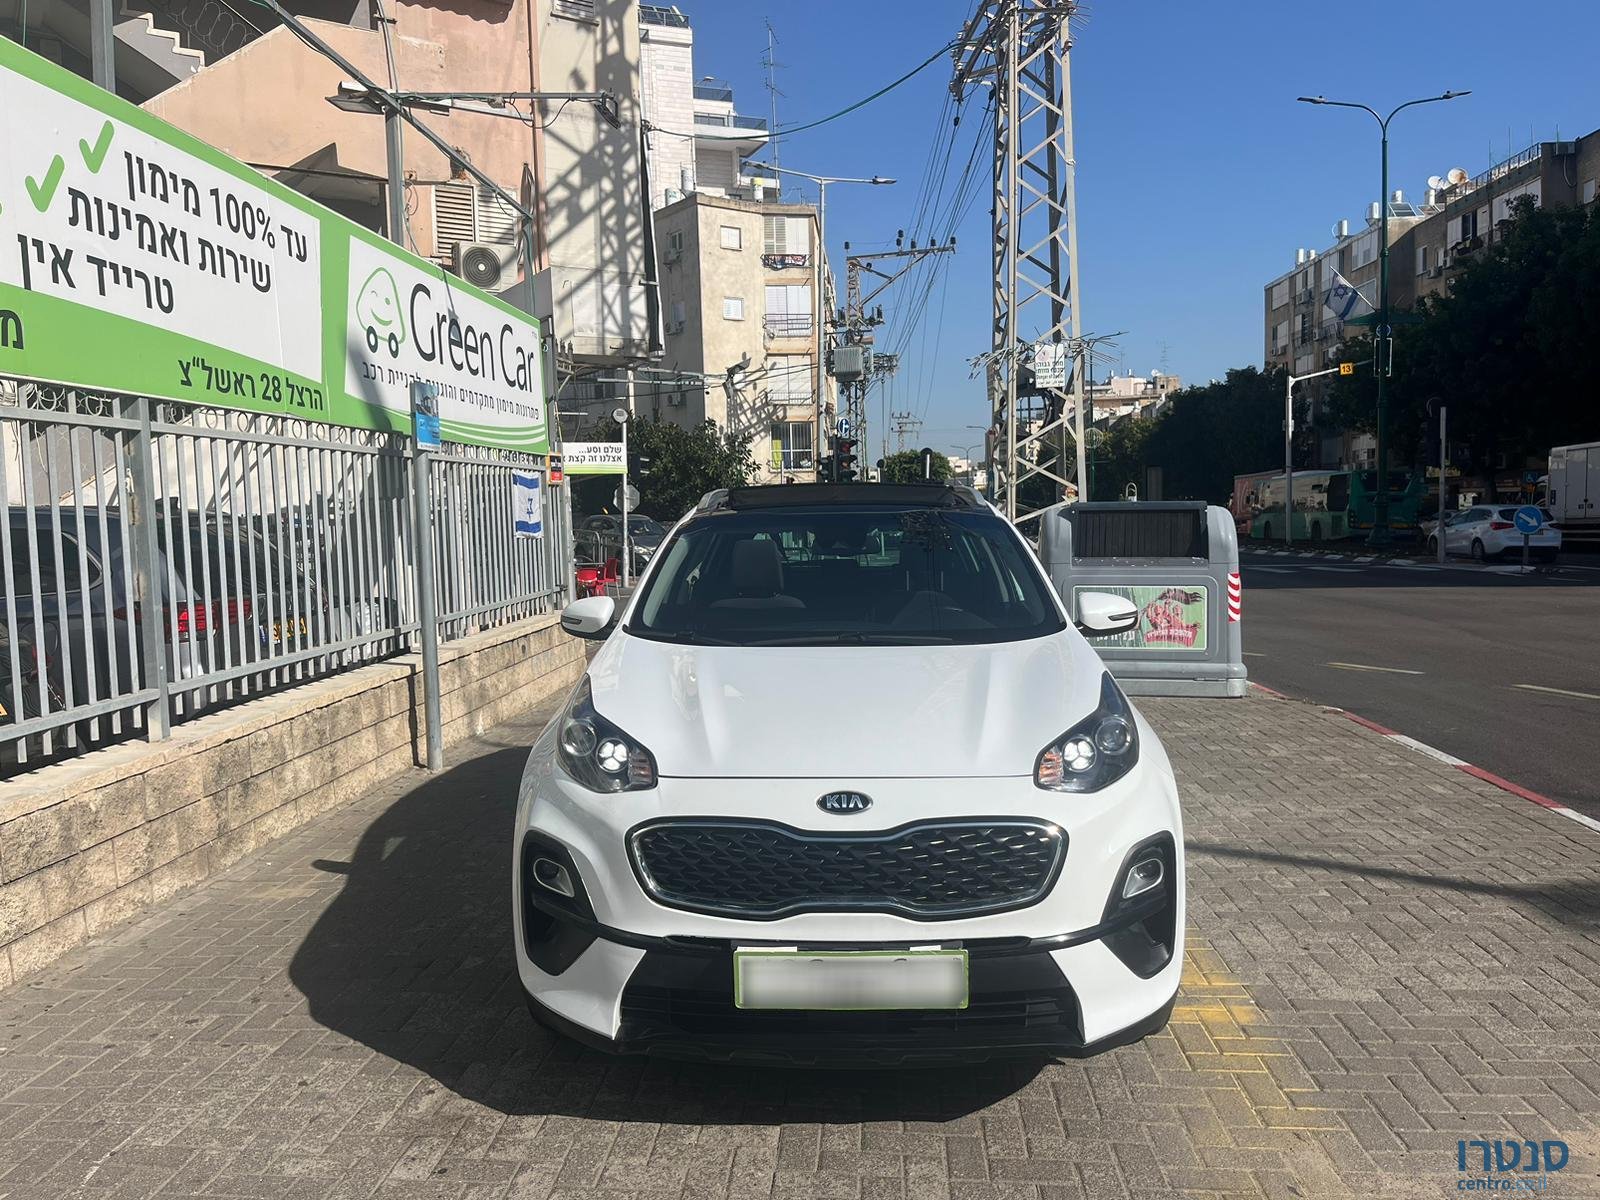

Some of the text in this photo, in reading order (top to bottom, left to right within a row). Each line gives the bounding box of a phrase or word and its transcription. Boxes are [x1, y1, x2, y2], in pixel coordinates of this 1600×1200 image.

[124, 151, 308, 262] עד 100% מימון
[67, 187, 271, 293] שירות ואמינות
[17, 234, 174, 313] טרייד אין
[410, 283, 535, 393] Green Car
[362, 361, 384, 382] רכב
[1341, 364, 1352, 373] 13
[260, 373, 282, 403] 28
[286, 377, 324, 411] הרצל
[459, 388, 495, 410] מתקדמים
[496, 398, 514, 414] מימון
[516, 403, 540, 420] פתרונות
[568, 454, 586, 464] קצת
[578, 445, 622, 454] שלם וסע...
[599, 454, 622, 463] אצלנו
[826, 794, 864, 809] KIA
